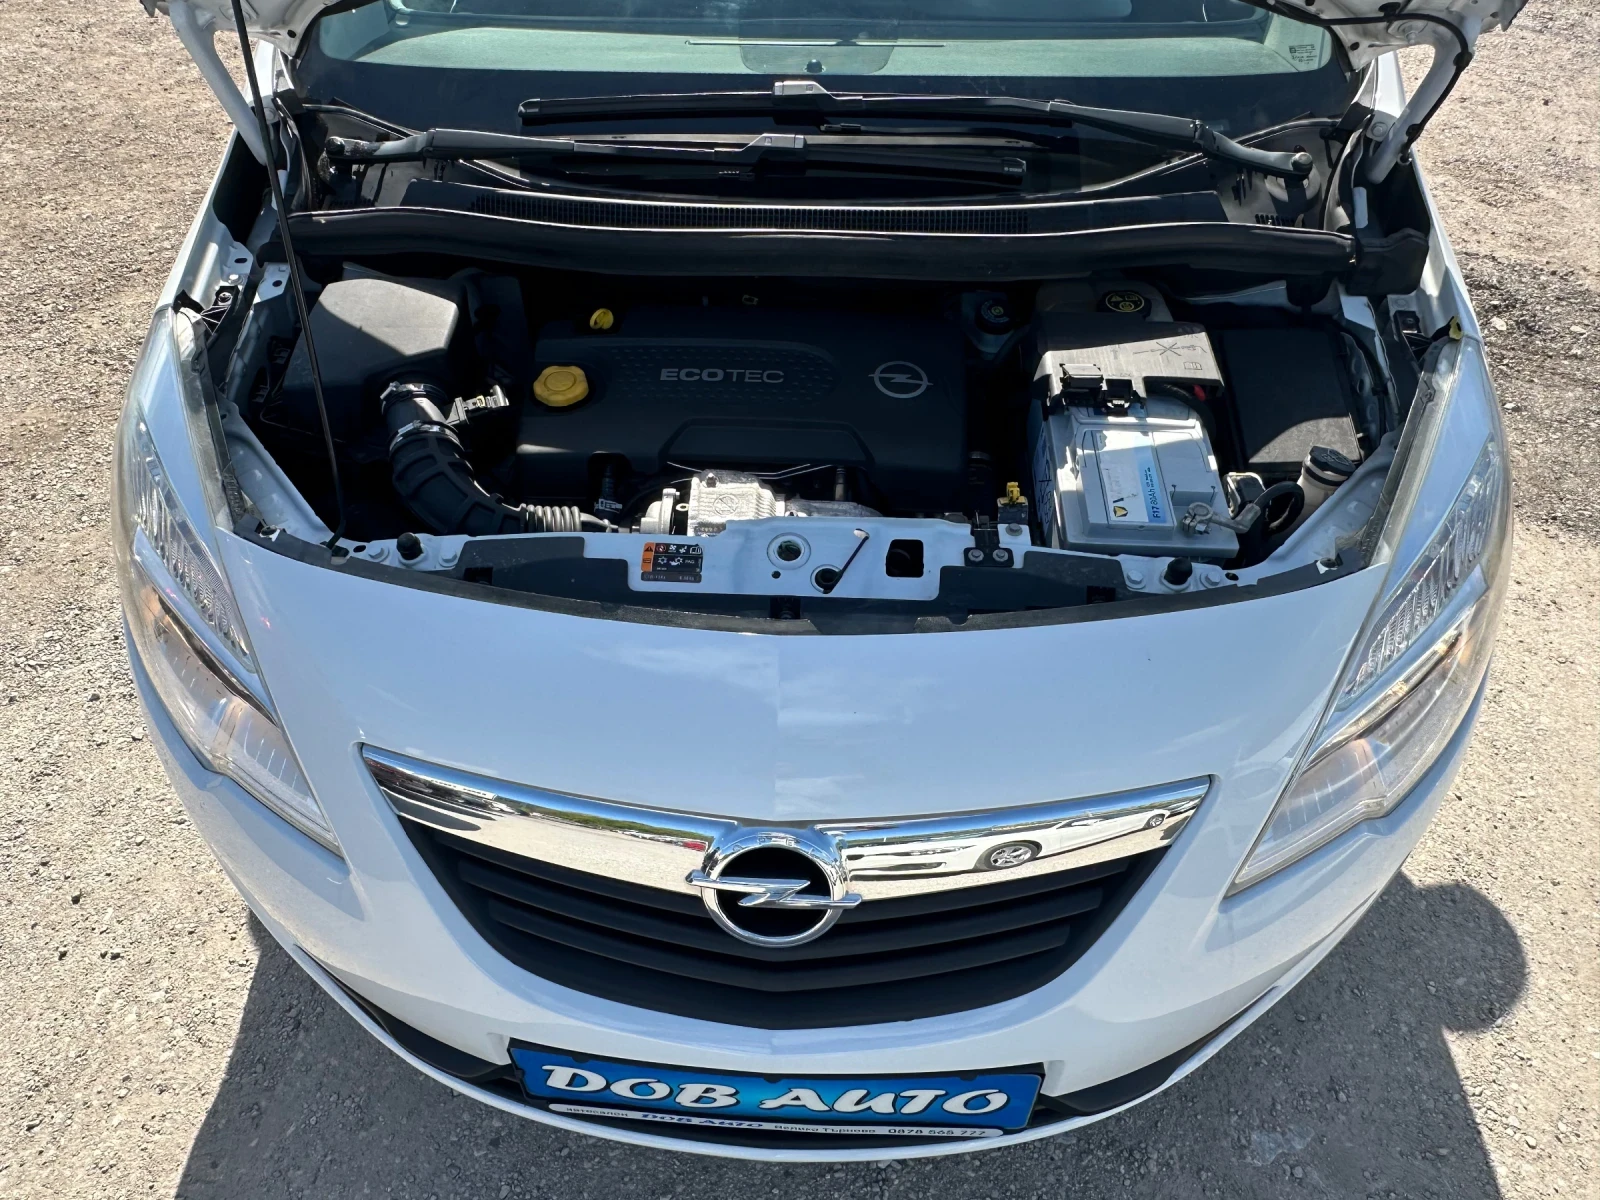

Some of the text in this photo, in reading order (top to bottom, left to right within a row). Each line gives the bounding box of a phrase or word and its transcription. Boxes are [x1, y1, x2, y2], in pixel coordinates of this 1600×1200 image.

[660, 368, 785, 383] ECOTEC
[542, 1065, 1008, 1115] DOB AUTO
